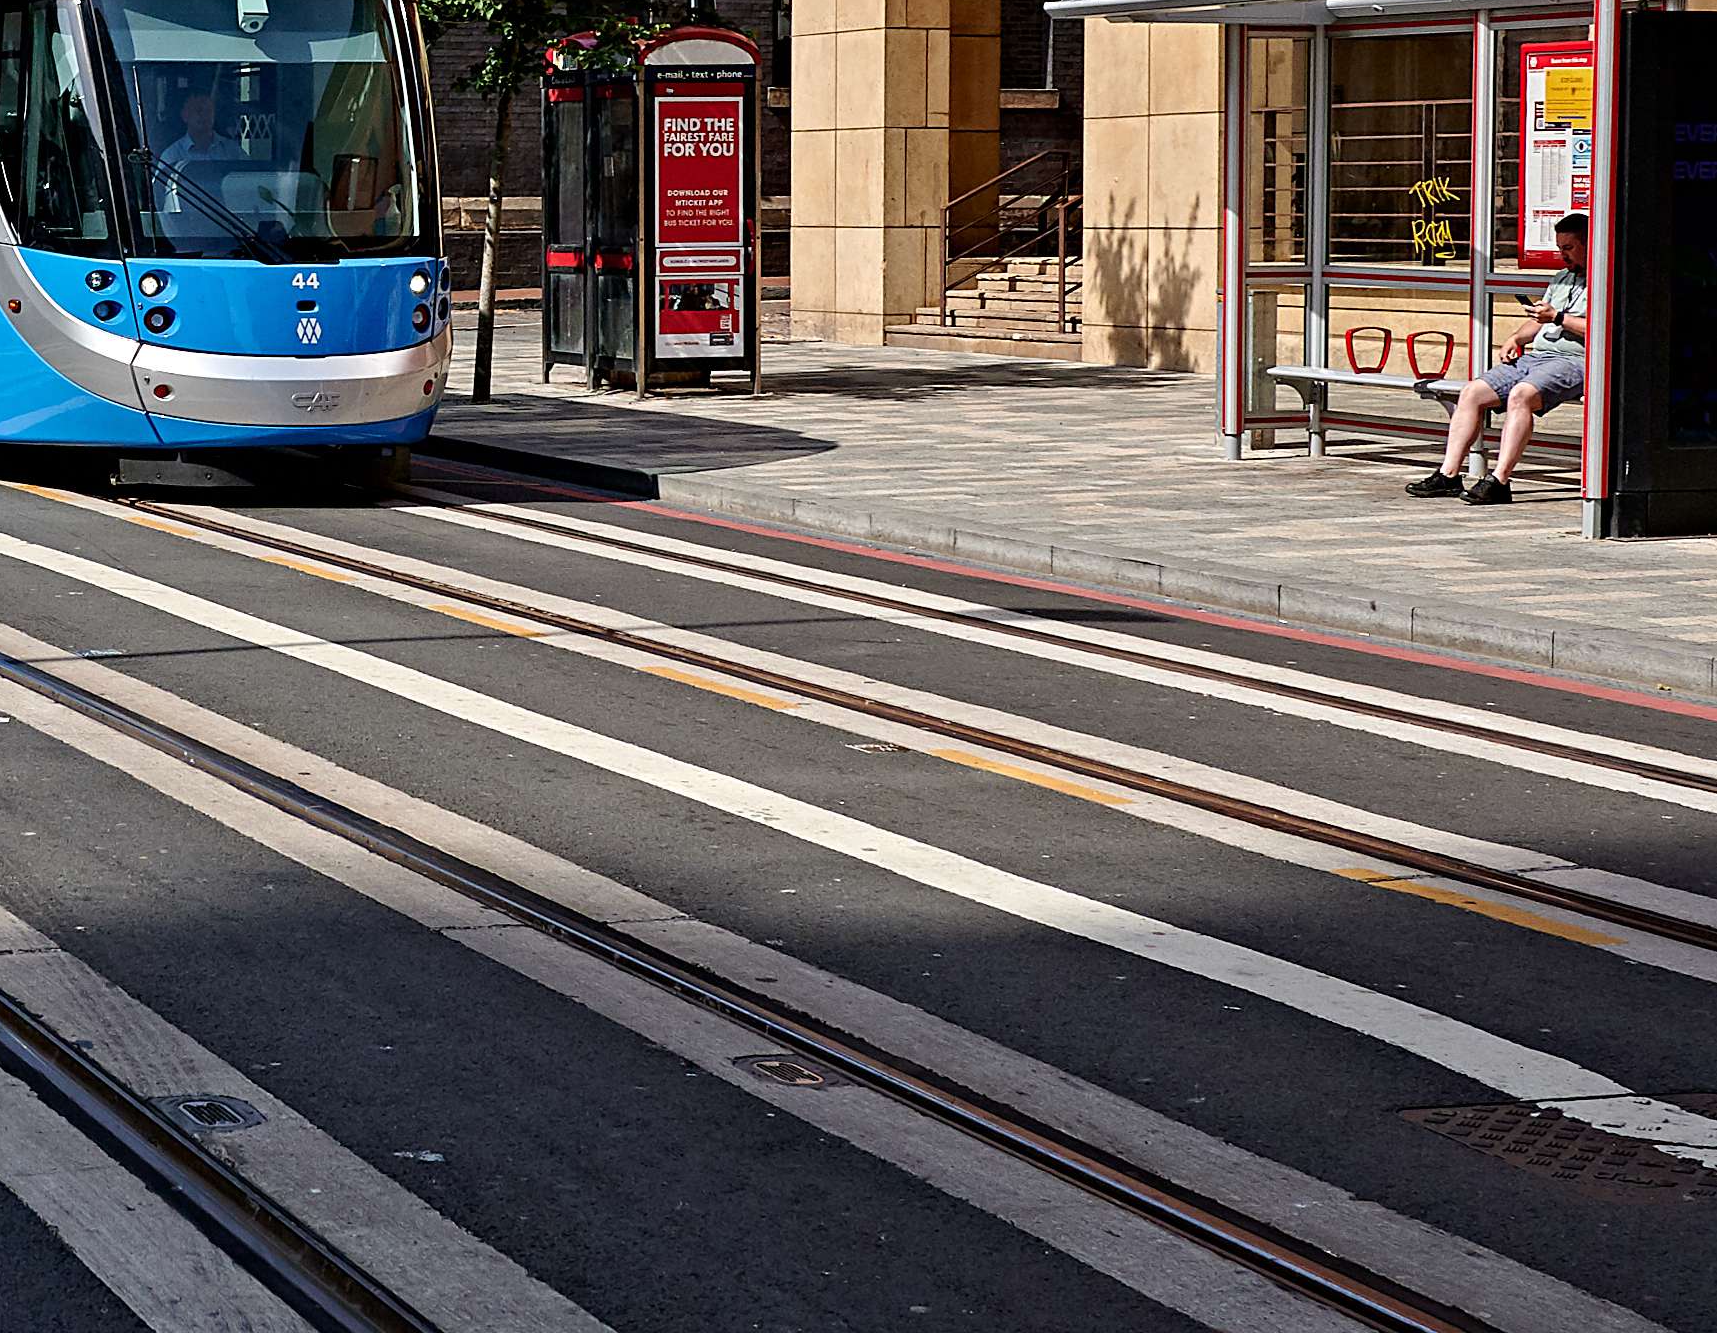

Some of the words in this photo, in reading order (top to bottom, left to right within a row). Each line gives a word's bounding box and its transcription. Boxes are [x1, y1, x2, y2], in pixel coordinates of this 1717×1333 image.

[657, 70, 684, 79] e-mail
[691, 71, 709, 79] text
[716, 70, 743, 80] phone
[664, 117, 701, 132] FIND
[704, 117, 735, 132] THE
[664, 132, 706, 142] FAIREST
[708, 132, 735, 142] FARE
[664, 142, 696, 157] FOR
[699, 142, 735, 157] YOU
[667, 189, 711, 197] DOWNLOAD
[665, 209, 676, 217] TO
[677, 209, 694, 217] FIND
[695, 209, 708, 217] THE
[709, 208, 730, 216] RIGHT
[664, 219, 677, 227] BUS
[678, 219, 701, 227] TICKET
[291, 272, 320, 290] 44
